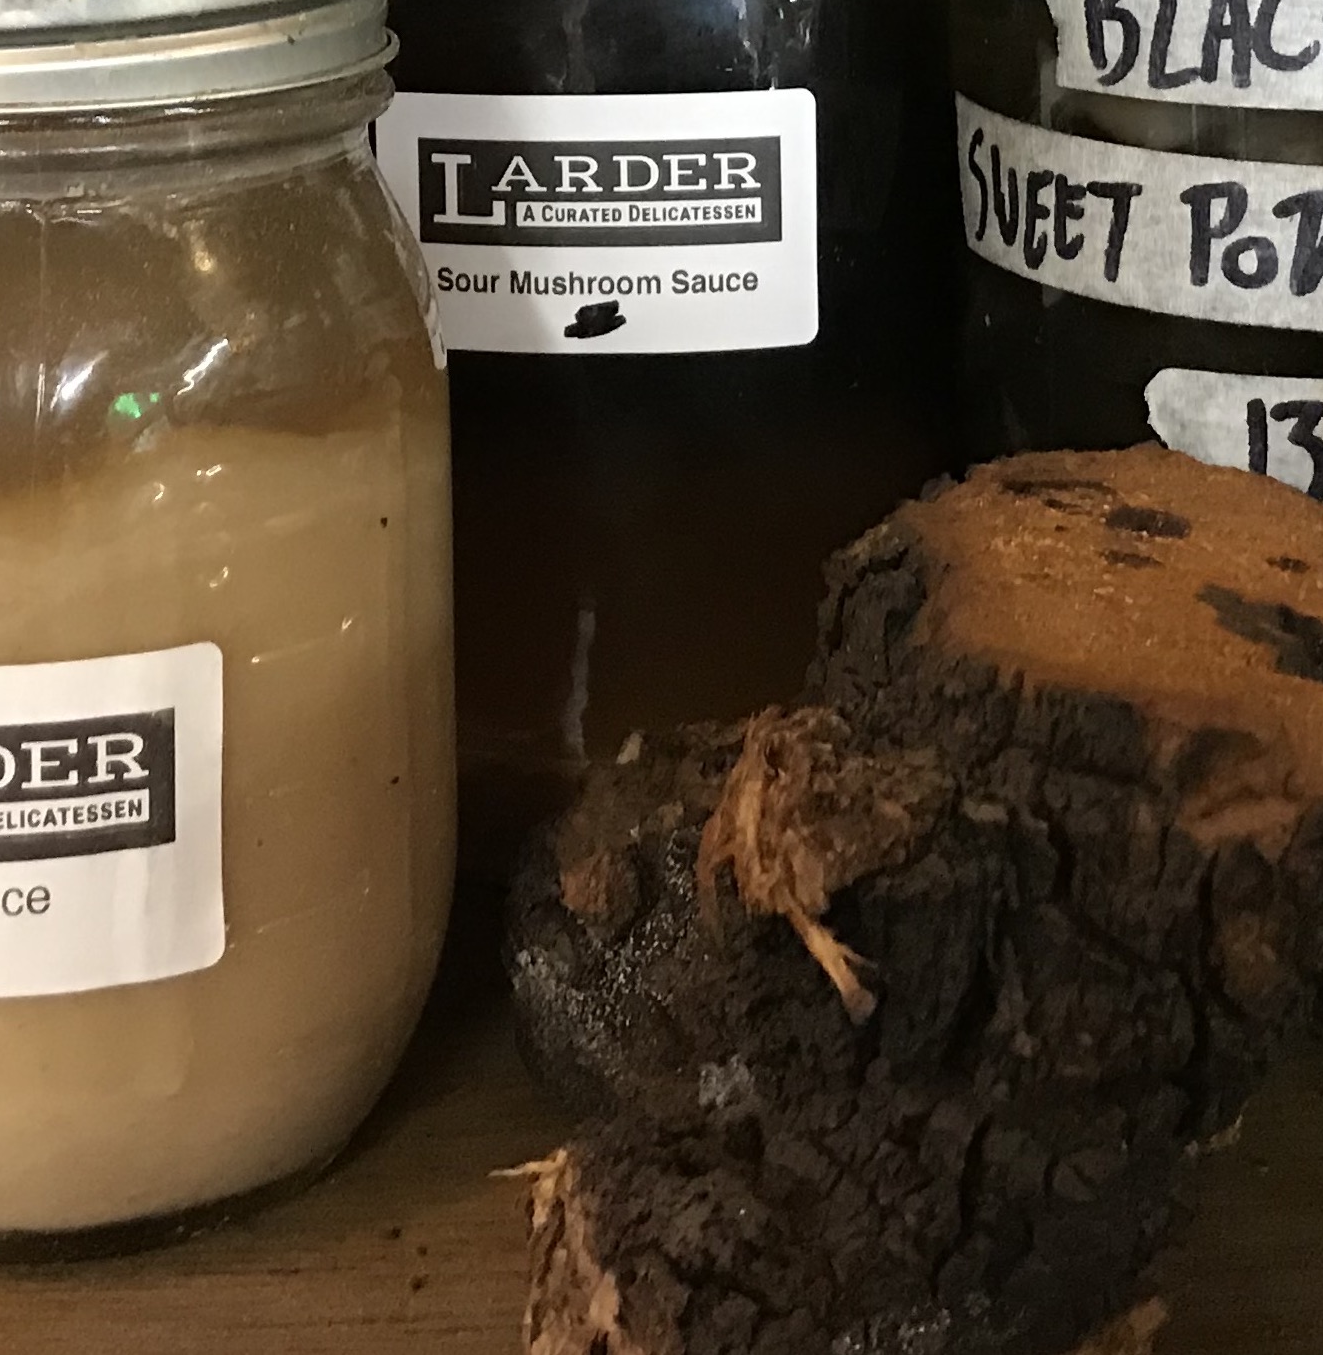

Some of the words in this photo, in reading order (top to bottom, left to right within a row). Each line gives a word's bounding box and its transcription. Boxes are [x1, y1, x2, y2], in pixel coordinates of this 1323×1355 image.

[431, 152, 761, 226] LARDER
[523, 205, 535, 223] A
[541, 204, 622, 223] CURATED
[628, 203, 757, 223] DELICATESSEN
[437, 267, 498, 294] Sour
[510, 270, 661, 296] Mushroom
[671, 269, 759, 294] Sauce
